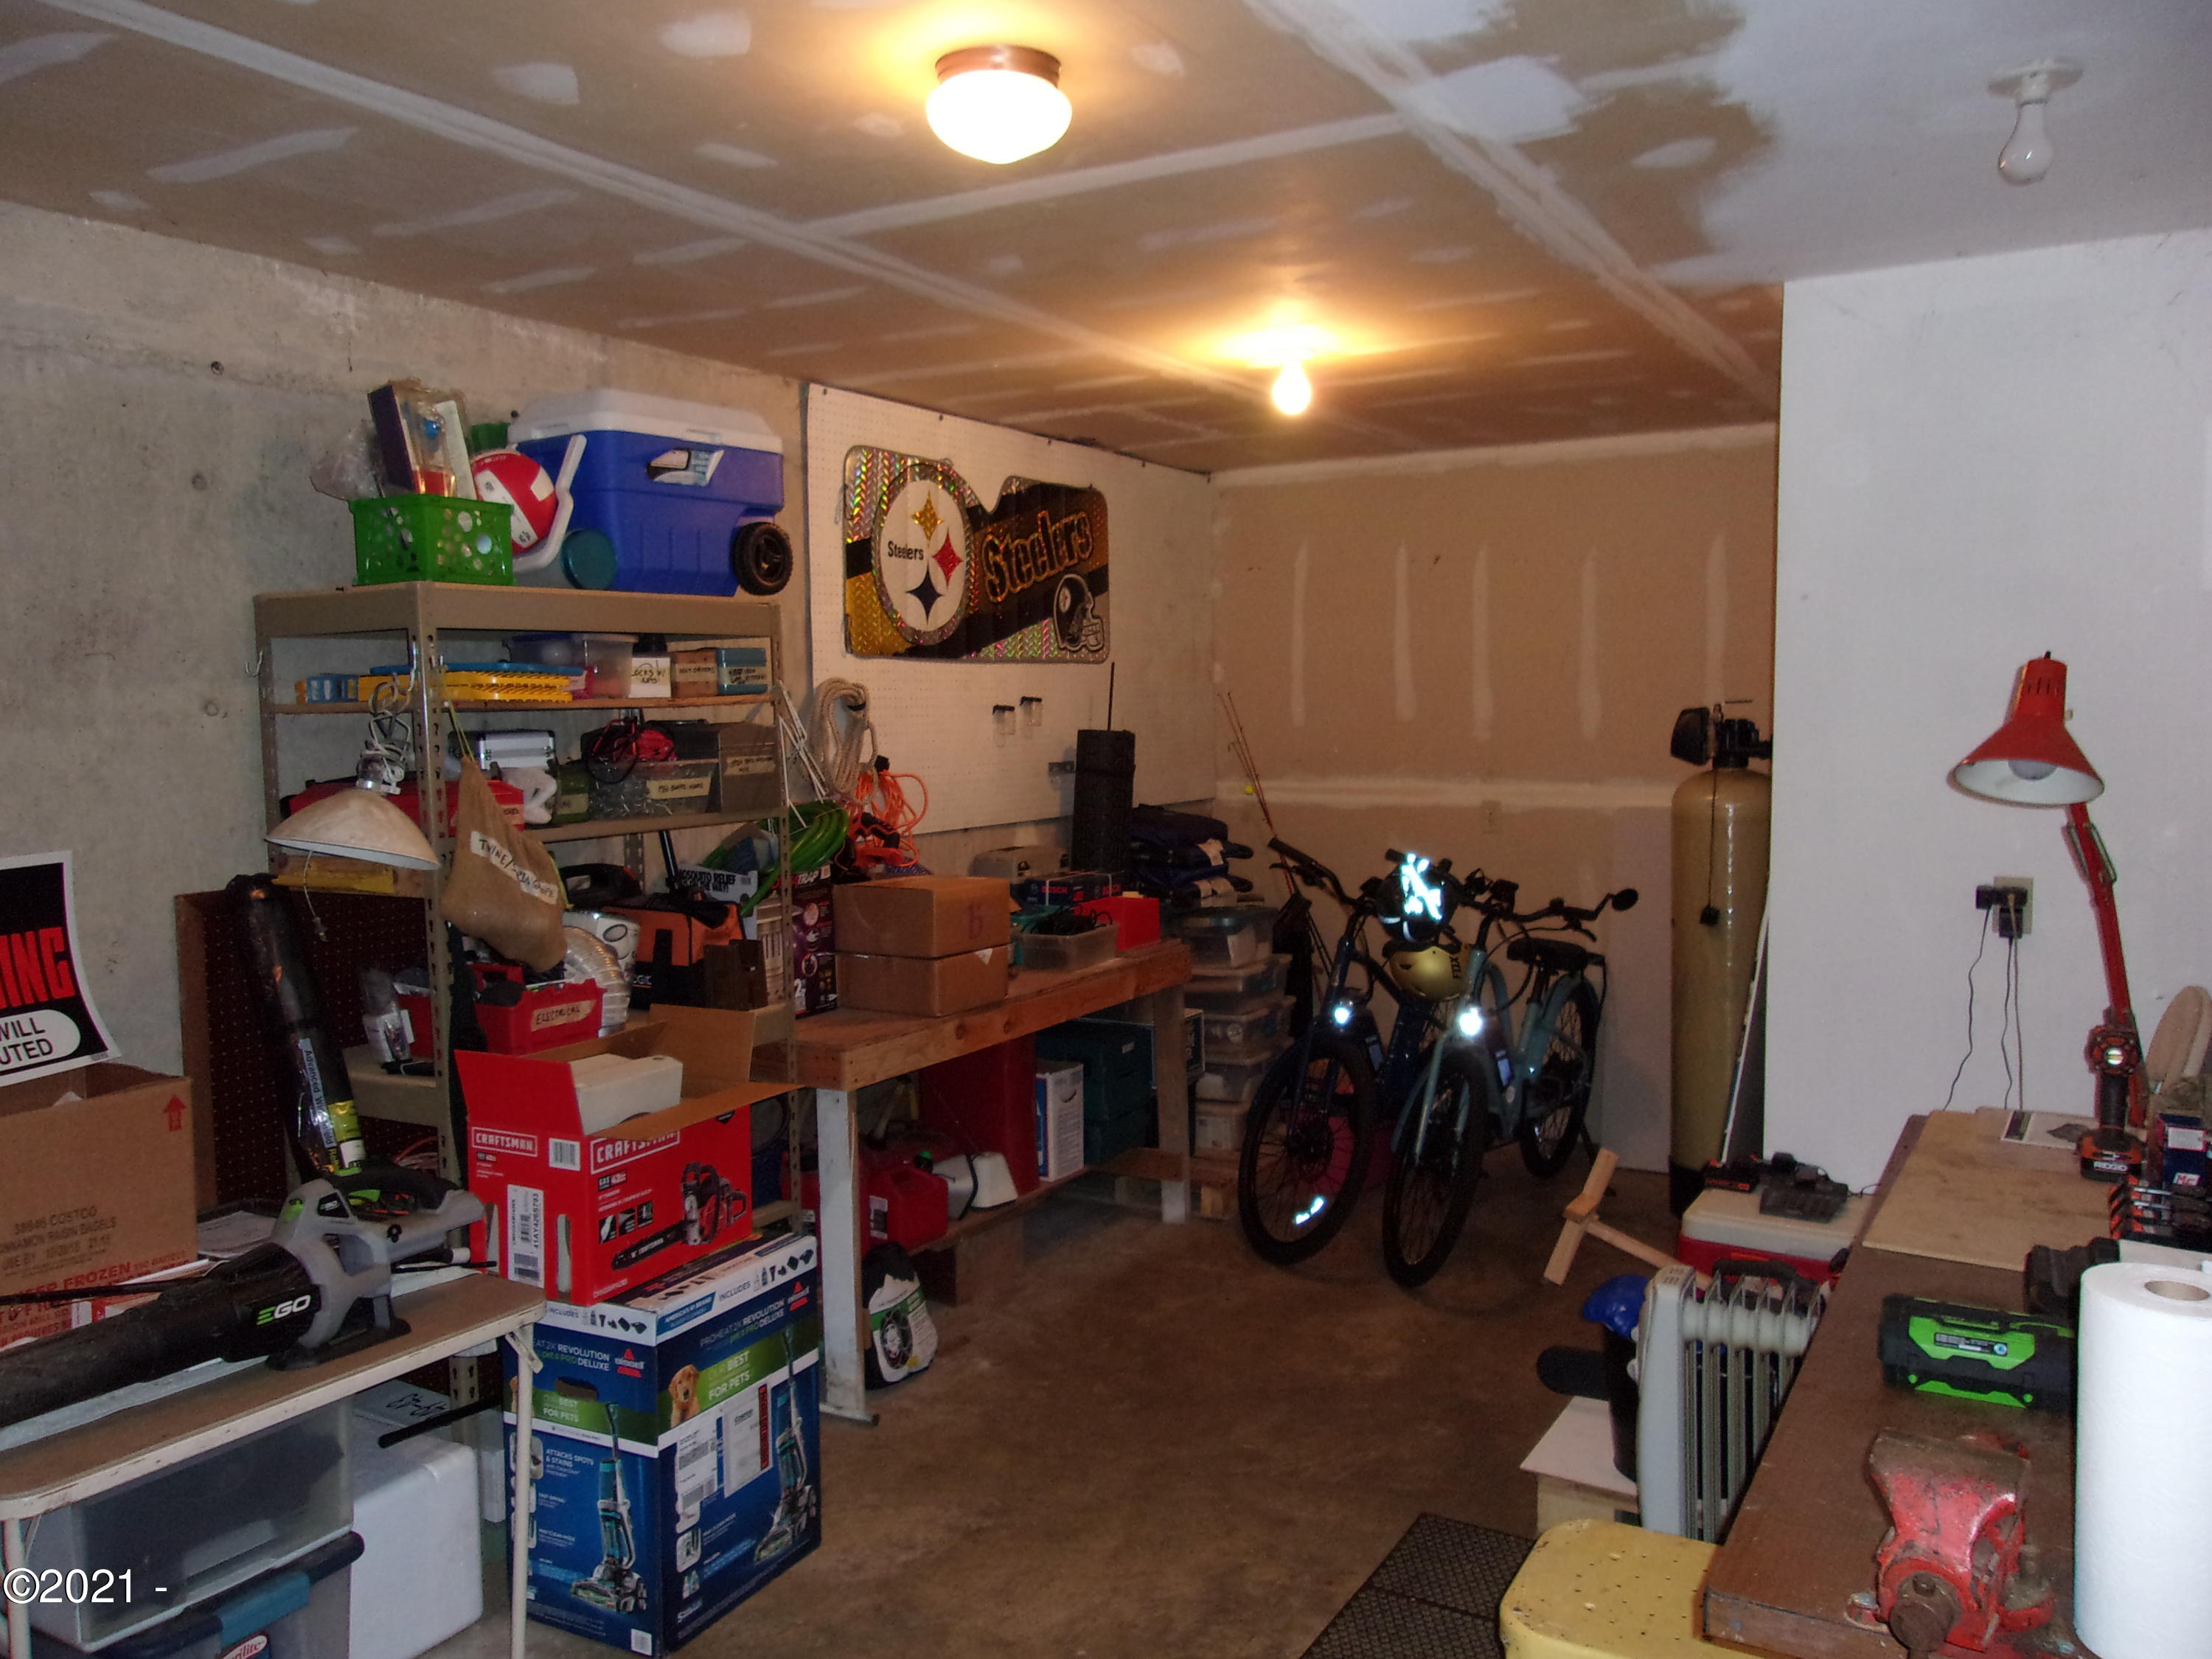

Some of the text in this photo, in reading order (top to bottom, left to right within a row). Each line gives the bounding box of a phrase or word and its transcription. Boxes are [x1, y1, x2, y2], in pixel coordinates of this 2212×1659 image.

[888, 541, 924, 560] Steelers
[982, 510, 1093, 602] Steelers
[0, 925, 76, 1011] ING
[475, 1132, 534, 1152] CRAFTSMAN
[63, 1262, 131, 1290] FROZEN
[719, 1281, 751, 1302] INCLUDES
[256, 1294, 311, 1326] EGO
[549, 1307, 580, 1319] INCLUDES
[742, 1298, 785, 1324] REVOLUTION
[759, 1308, 785, 1328] DELUXE
[558, 1343, 611, 1362] REVOLUTION
[727, 1350, 750, 1370] BEST
[577, 1357, 611, 1371] DELUXE
[708, 1371, 751, 1400] FOR PETS
[558, 1397, 578, 1408] BEST
[543, 1408, 559, 1418] FOR
[560, 1411, 580, 1423] PETS
